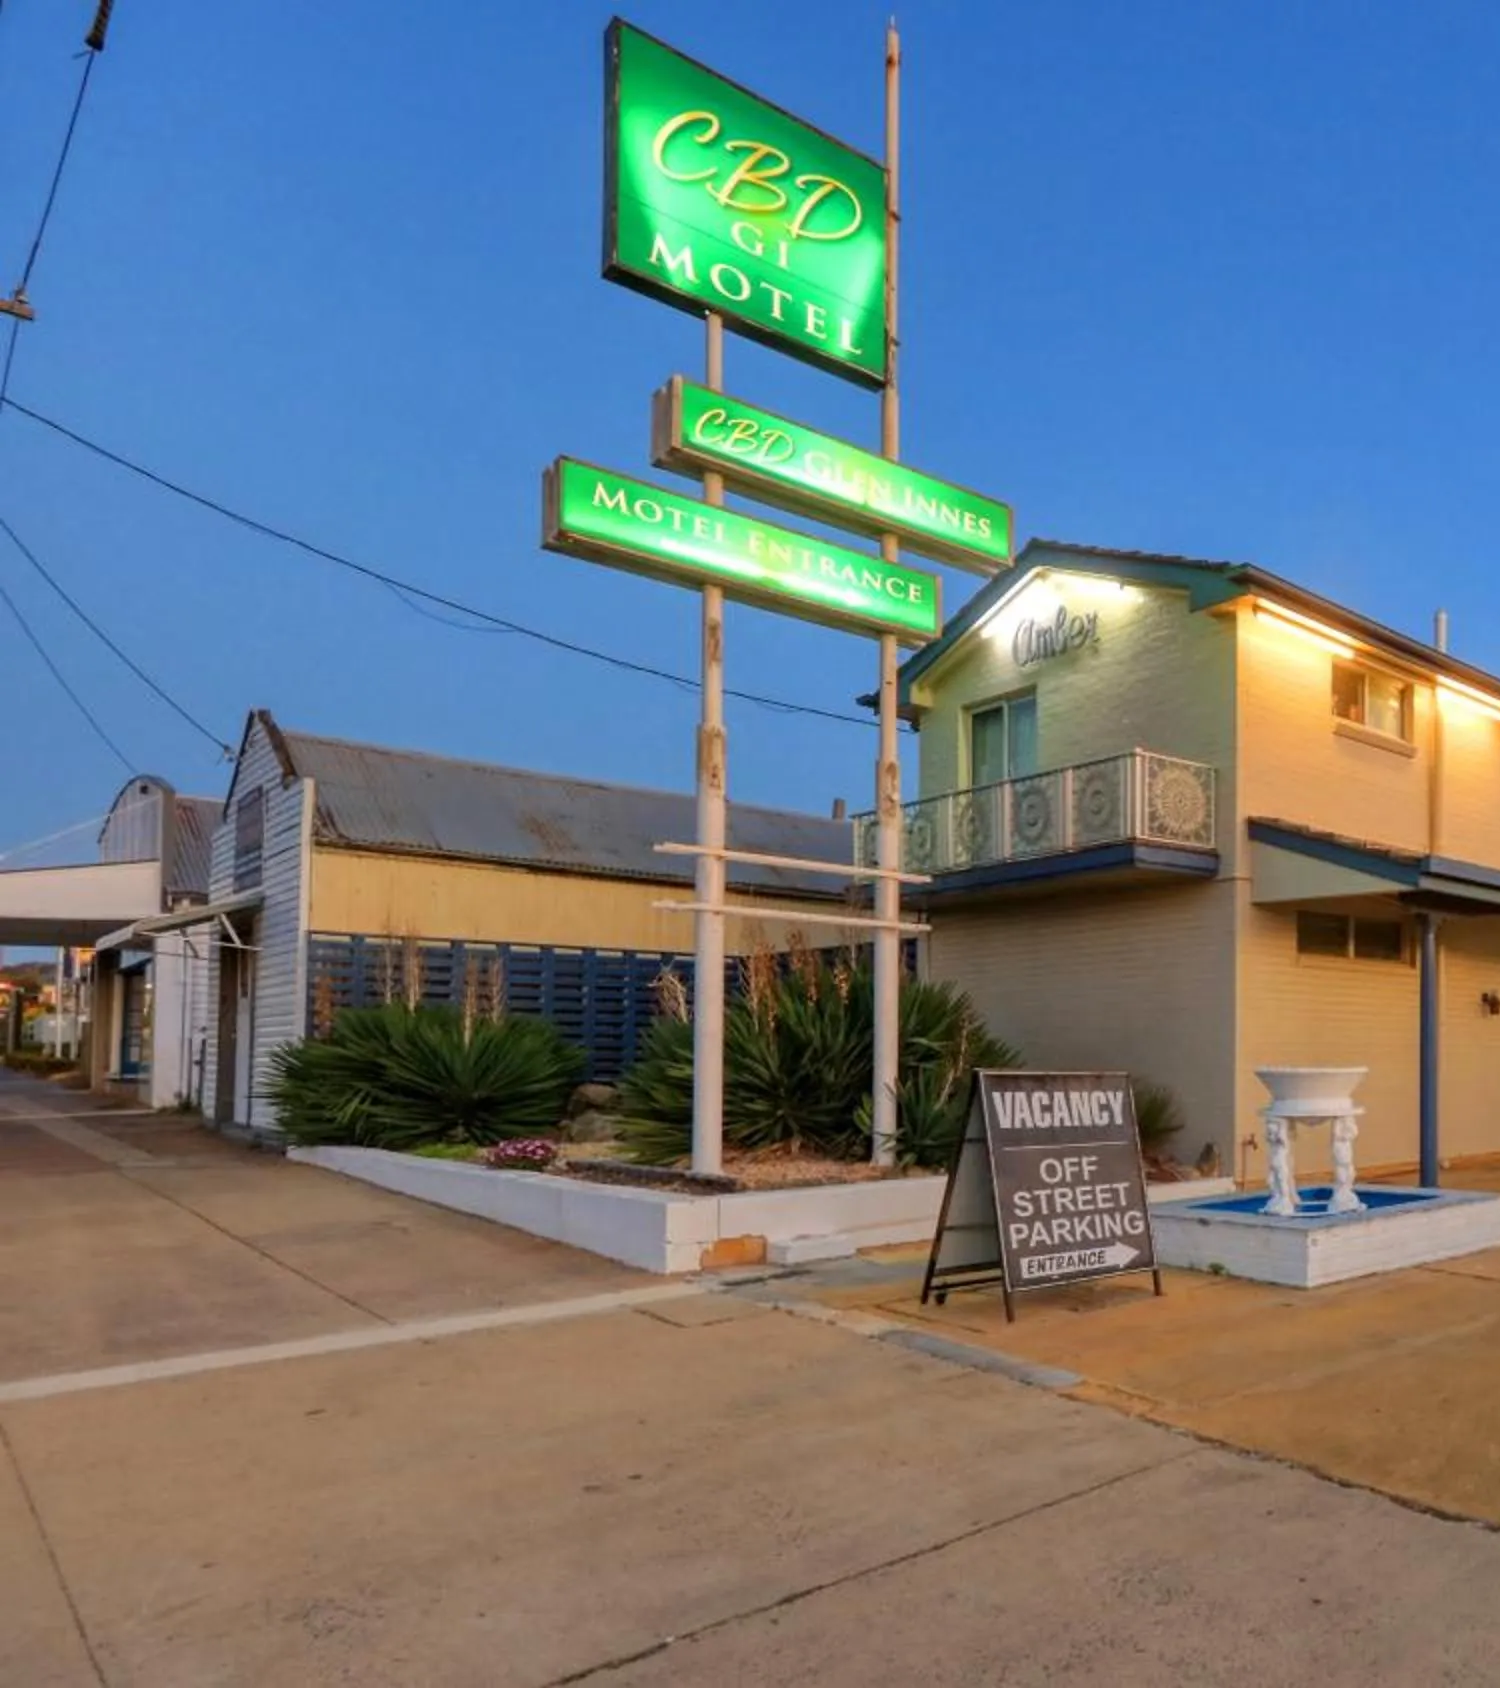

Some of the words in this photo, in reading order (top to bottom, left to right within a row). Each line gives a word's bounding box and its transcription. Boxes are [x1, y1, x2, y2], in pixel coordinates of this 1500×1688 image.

[651, 110, 863, 242] CBD
[731, 221, 791, 271] GI
[648, 232, 863, 356] MOTEL
[695, 408, 794, 463] CBD
[804, 451, 892, 507] GLEN
[903, 487, 991, 539] INNES
[591, 481, 727, 544] MOTEL
[748, 529, 923, 604] ENTRANCE
[992, 1090, 1124, 1129] VACANCY
[1039, 1155, 1099, 1184] OFF
[1012, 1182, 1131, 1218] STREET
[1008, 1211, 1145, 1249] PARKING
[1026, 1250, 1106, 1274] ENTRANCE
